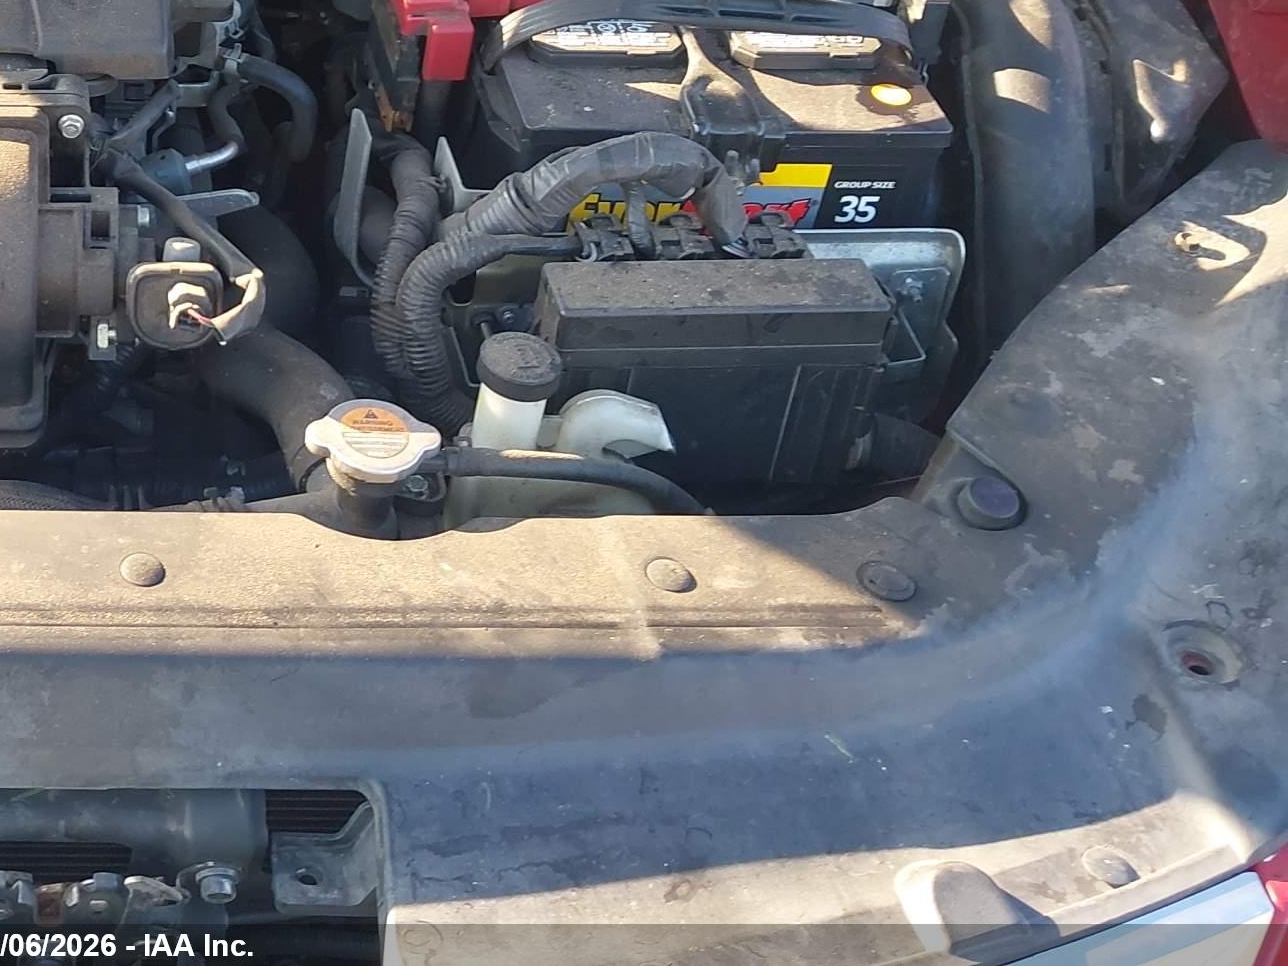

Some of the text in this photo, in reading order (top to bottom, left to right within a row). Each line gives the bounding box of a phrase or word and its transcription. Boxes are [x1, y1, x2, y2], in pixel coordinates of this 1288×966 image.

[834, 181, 896, 189] GROUP SIZE
[834, 195, 881, 223] 35
